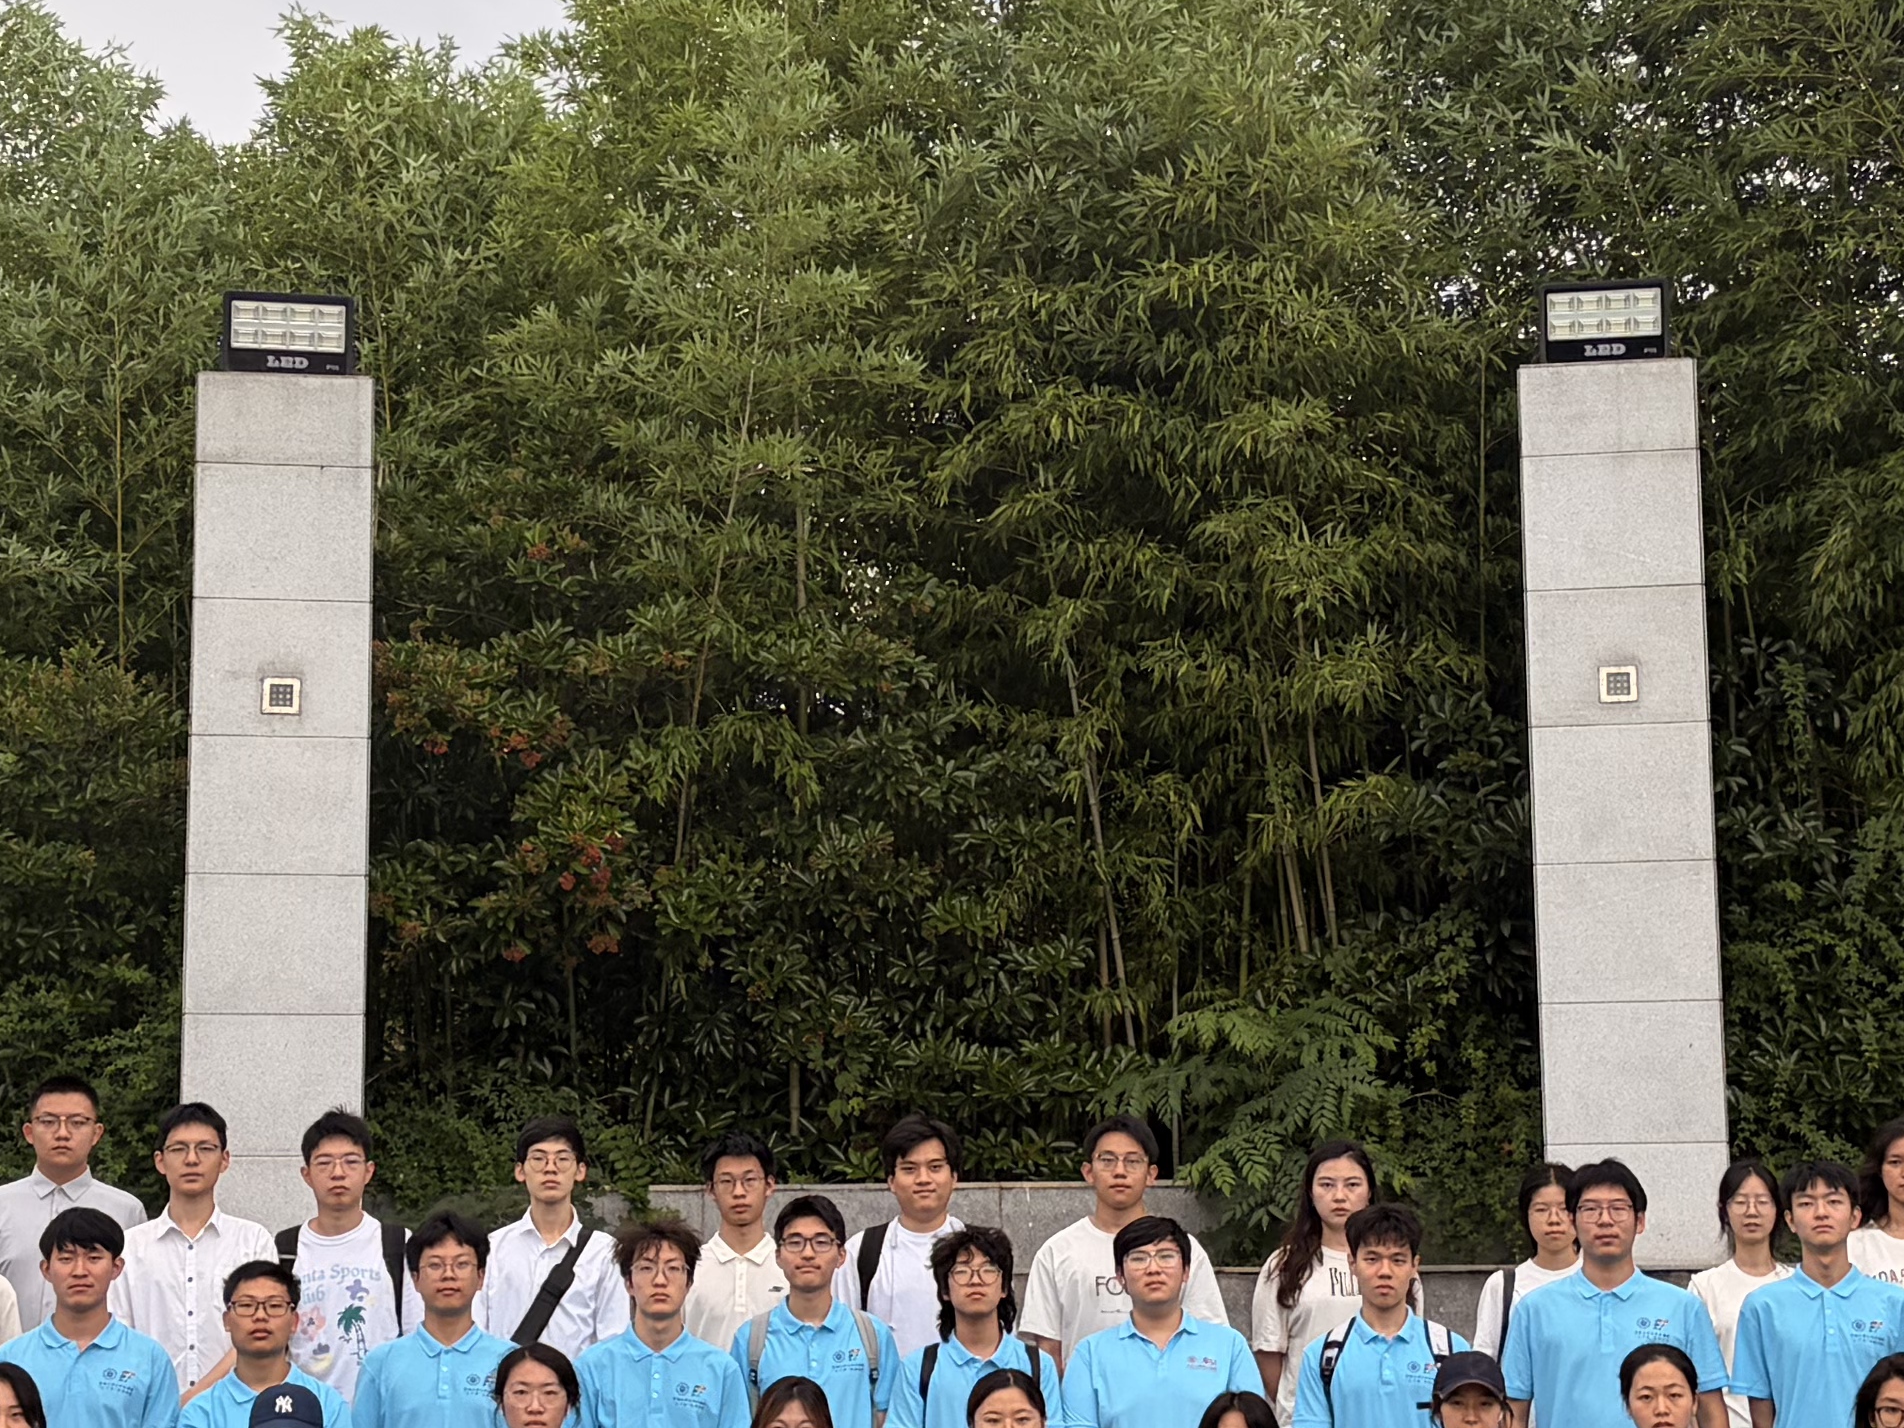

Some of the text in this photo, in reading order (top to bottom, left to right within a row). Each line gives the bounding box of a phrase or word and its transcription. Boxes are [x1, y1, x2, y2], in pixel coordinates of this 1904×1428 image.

[1584, 343, 1626, 357] LED
[266, 355, 309, 369] LED
[302, 1264, 382, 1285] nta Sports
[302, 1284, 326, 1305] lub
[1095, 1276, 1124, 1296] FO
